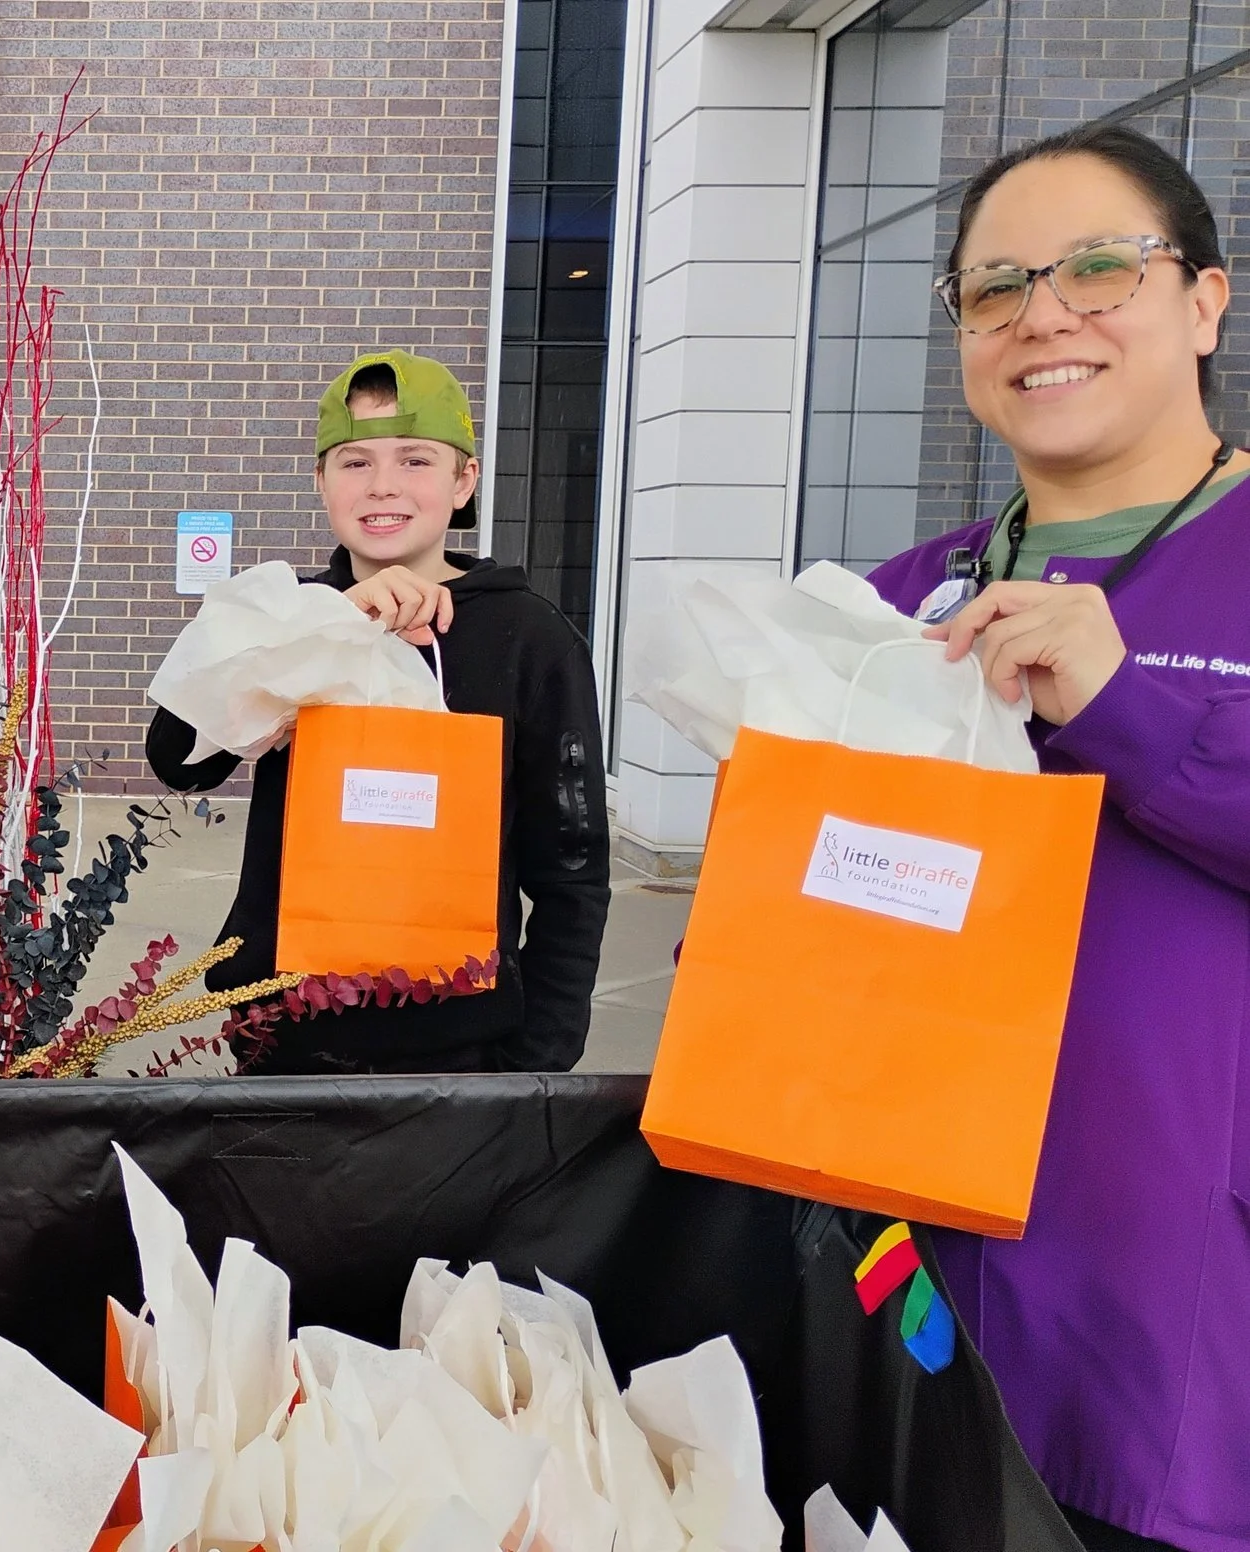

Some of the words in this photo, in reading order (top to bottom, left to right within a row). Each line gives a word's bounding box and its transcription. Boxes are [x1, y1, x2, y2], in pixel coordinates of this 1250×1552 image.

[1135, 652, 1169, 666] hild
[1171, 653, 1206, 669] Life
[360, 785, 389, 798] little
[391, 789, 434, 803] giraffe
[843, 846, 890, 871] little
[894, 860, 968, 890] giraffe
[847, 870, 928, 898] foundation
